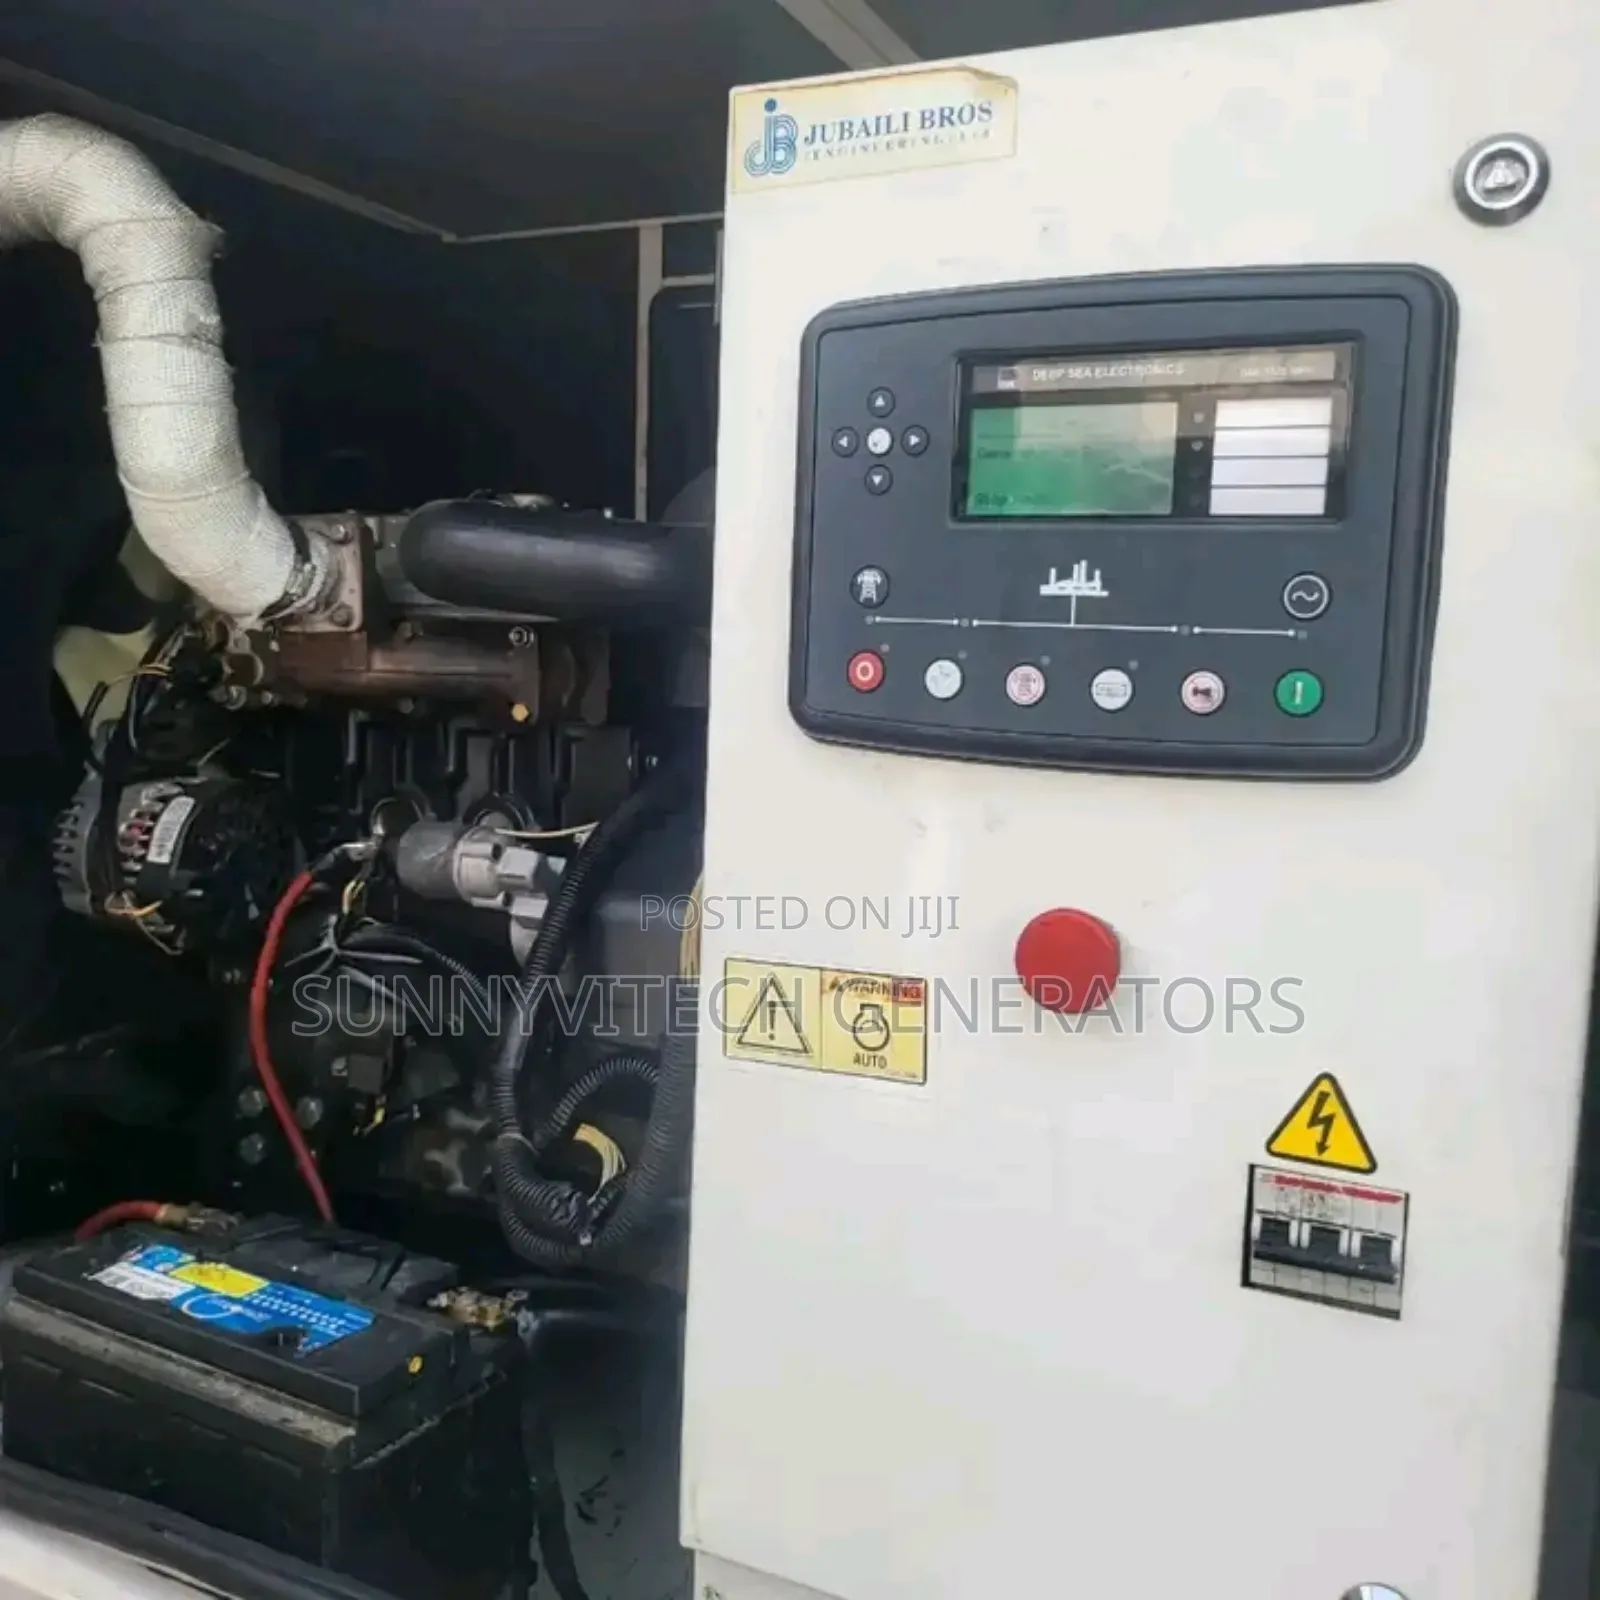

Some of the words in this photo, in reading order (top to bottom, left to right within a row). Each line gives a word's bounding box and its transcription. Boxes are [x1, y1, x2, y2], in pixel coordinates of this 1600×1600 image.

[803, 110, 909, 146] JUBAILI
[919, 100, 993, 132] BROS
[1067, 365, 1092, 379] SEA
[848, 976, 922, 999] WARNING
[853, 1052, 888, 1070] AUTO
